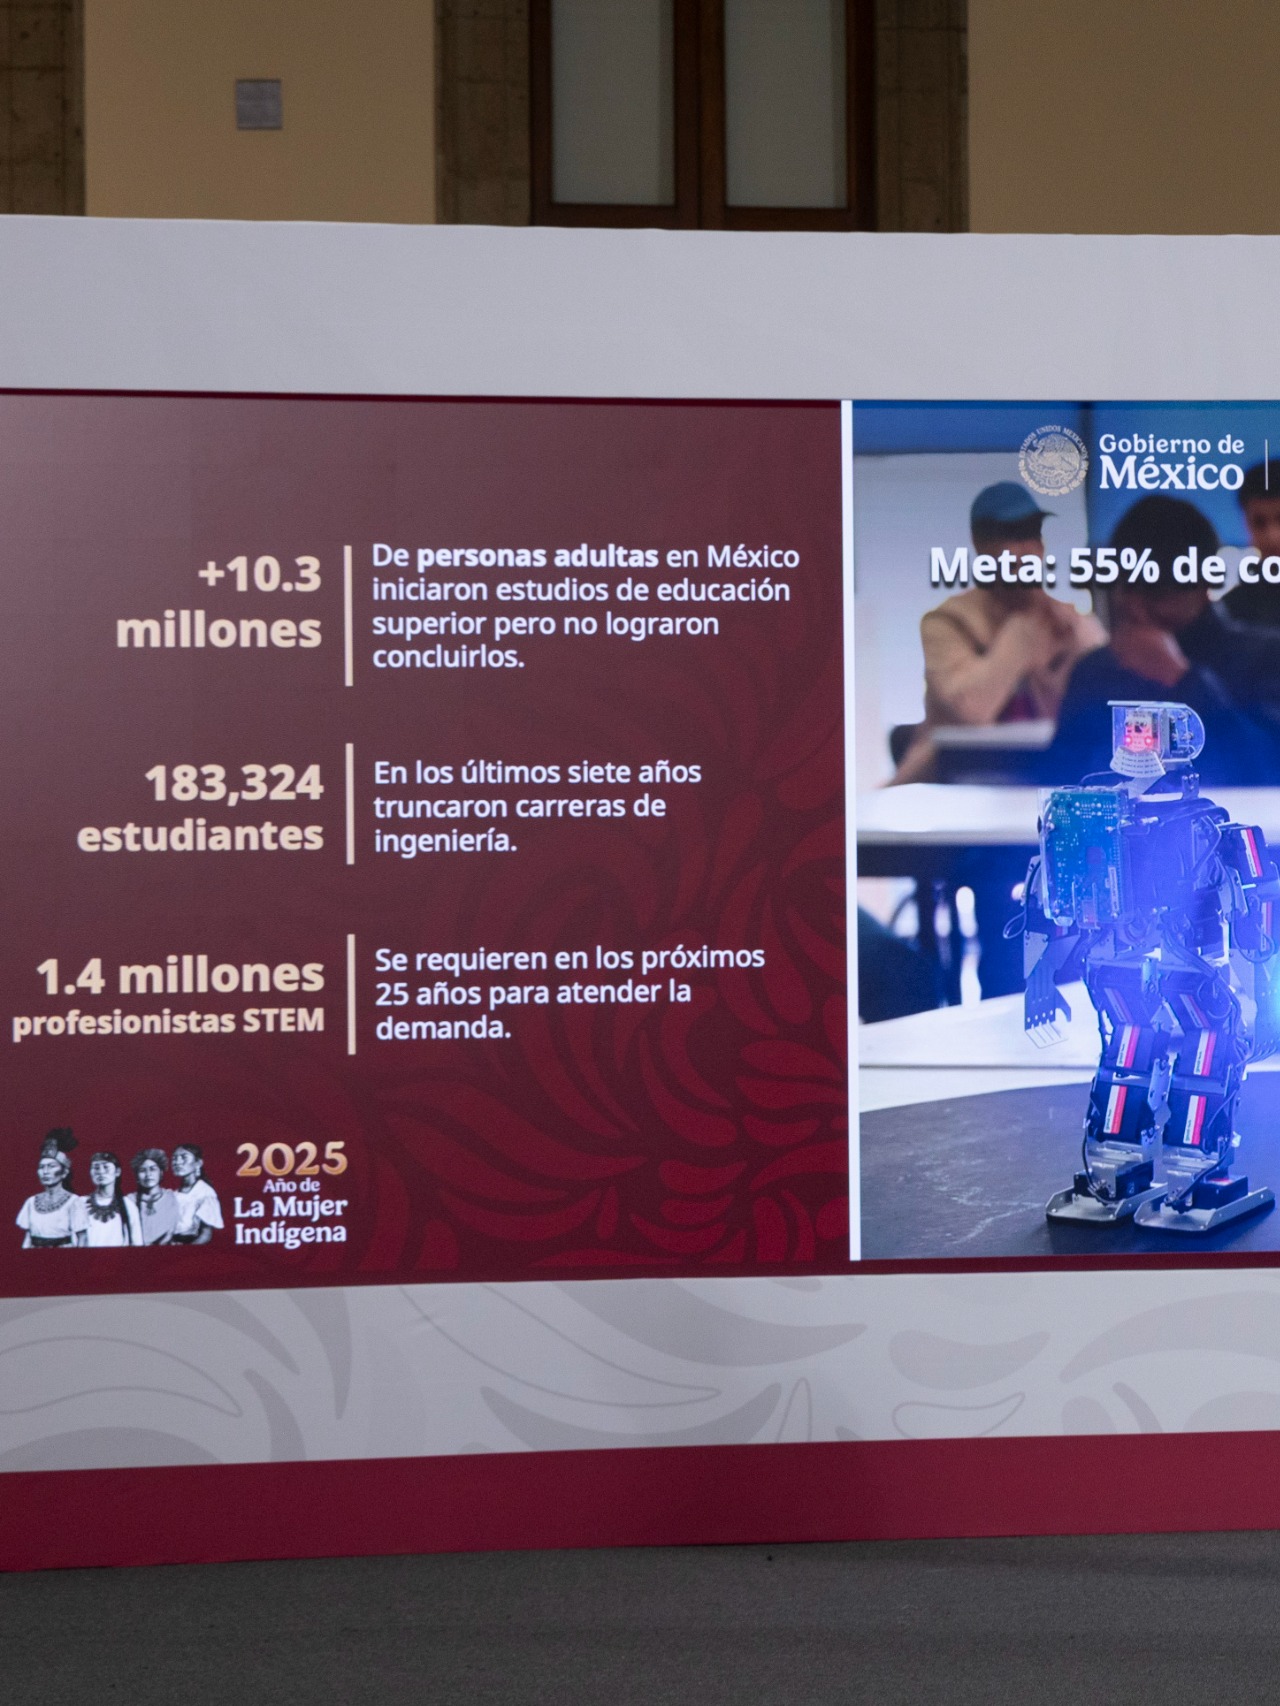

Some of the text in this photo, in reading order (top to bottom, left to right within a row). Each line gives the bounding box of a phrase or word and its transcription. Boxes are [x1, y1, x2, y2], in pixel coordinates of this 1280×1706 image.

[1099, 433, 1245, 454] Gobierno de
[1099, 454, 1245, 491] México
[198, 555, 321, 592] +10.3
[372, 543, 800, 572] De personas adultas en México
[930, 546, 1056, 583] Meta:
[1069, 547, 1160, 583] 55%
[1172, 546, 1226, 583] de
[373, 577, 790, 602] iniciaron estudios de educación
[116, 609, 322, 648] millones
[372, 610, 719, 642] superior pero no lograron
[372, 643, 525, 668] concluirlos.
[145, 763, 324, 807] 183,324
[374, 759, 702, 784] En los últimos siete años
[373, 792, 667, 819] truncaron carreras de
[77, 817, 324, 852] estudiantes
[375, 827, 517, 859] ingeniería.
[36, 954, 325, 995] 1.4 millones
[375, 944, 766, 978] Se requieren en los próximos
[375, 978, 691, 1011] 25 años para atender la
[12, 1007, 325, 1043] profesionistas STEM
[376, 1014, 511, 1041] demanda.
[236, 1141, 348, 1176] 2025
[263, 1177, 320, 1193] Año de
[234, 1195, 348, 1222] La Mujer
[235, 1220, 347, 1249] Indígena
